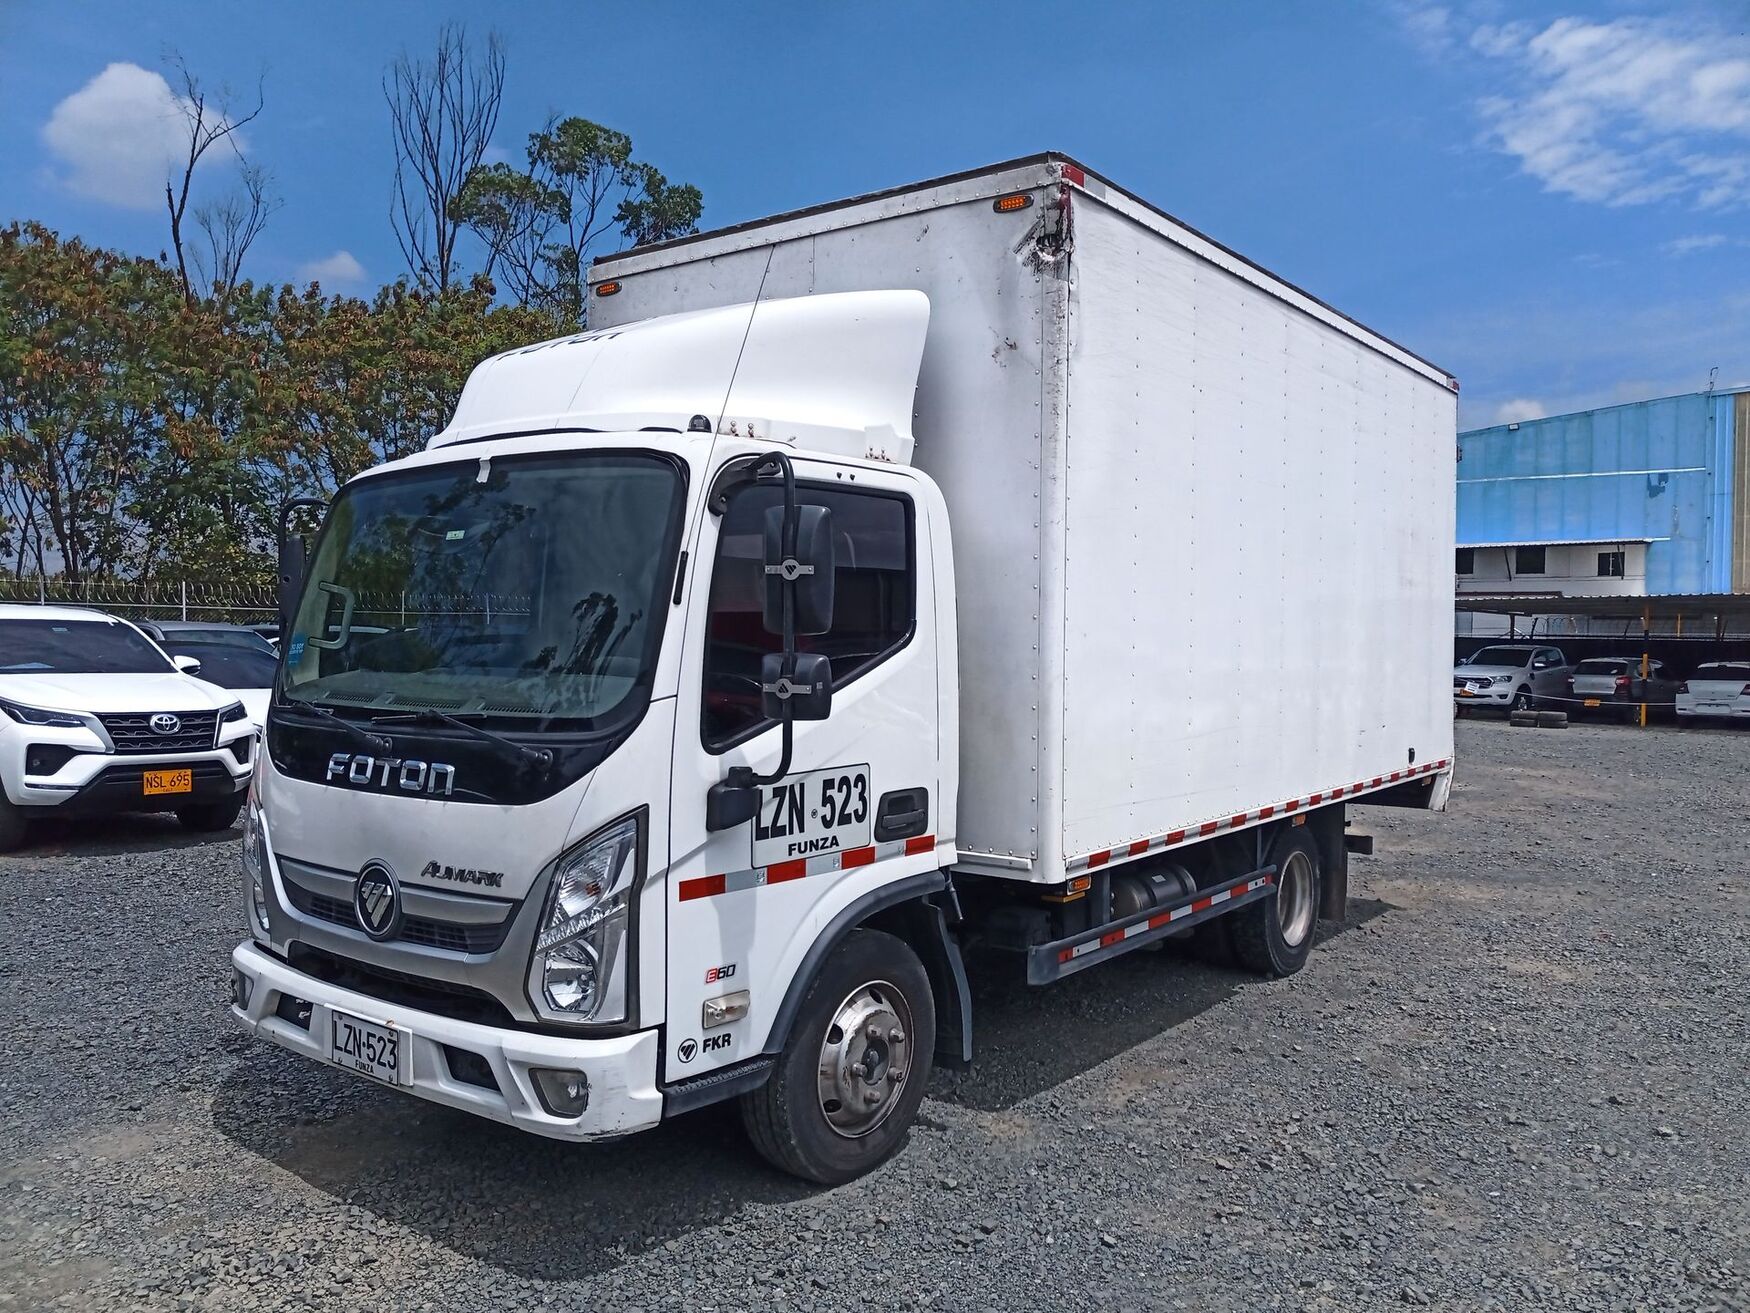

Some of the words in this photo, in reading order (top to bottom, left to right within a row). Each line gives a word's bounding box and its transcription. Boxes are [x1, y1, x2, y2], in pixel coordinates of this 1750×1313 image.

[146, 776, 166, 788] NSL
[170, 774, 189, 786] 695
[326, 753, 455, 796] FOTON
[755, 782, 805, 841] LZN
[820, 773, 868, 829] 523
[788, 835, 839, 857] FUNZA
[421, 860, 504, 887] AUMARK
[702, 1033, 731, 1053] FKR
[355, 1059, 375, 1074] FUNZA
